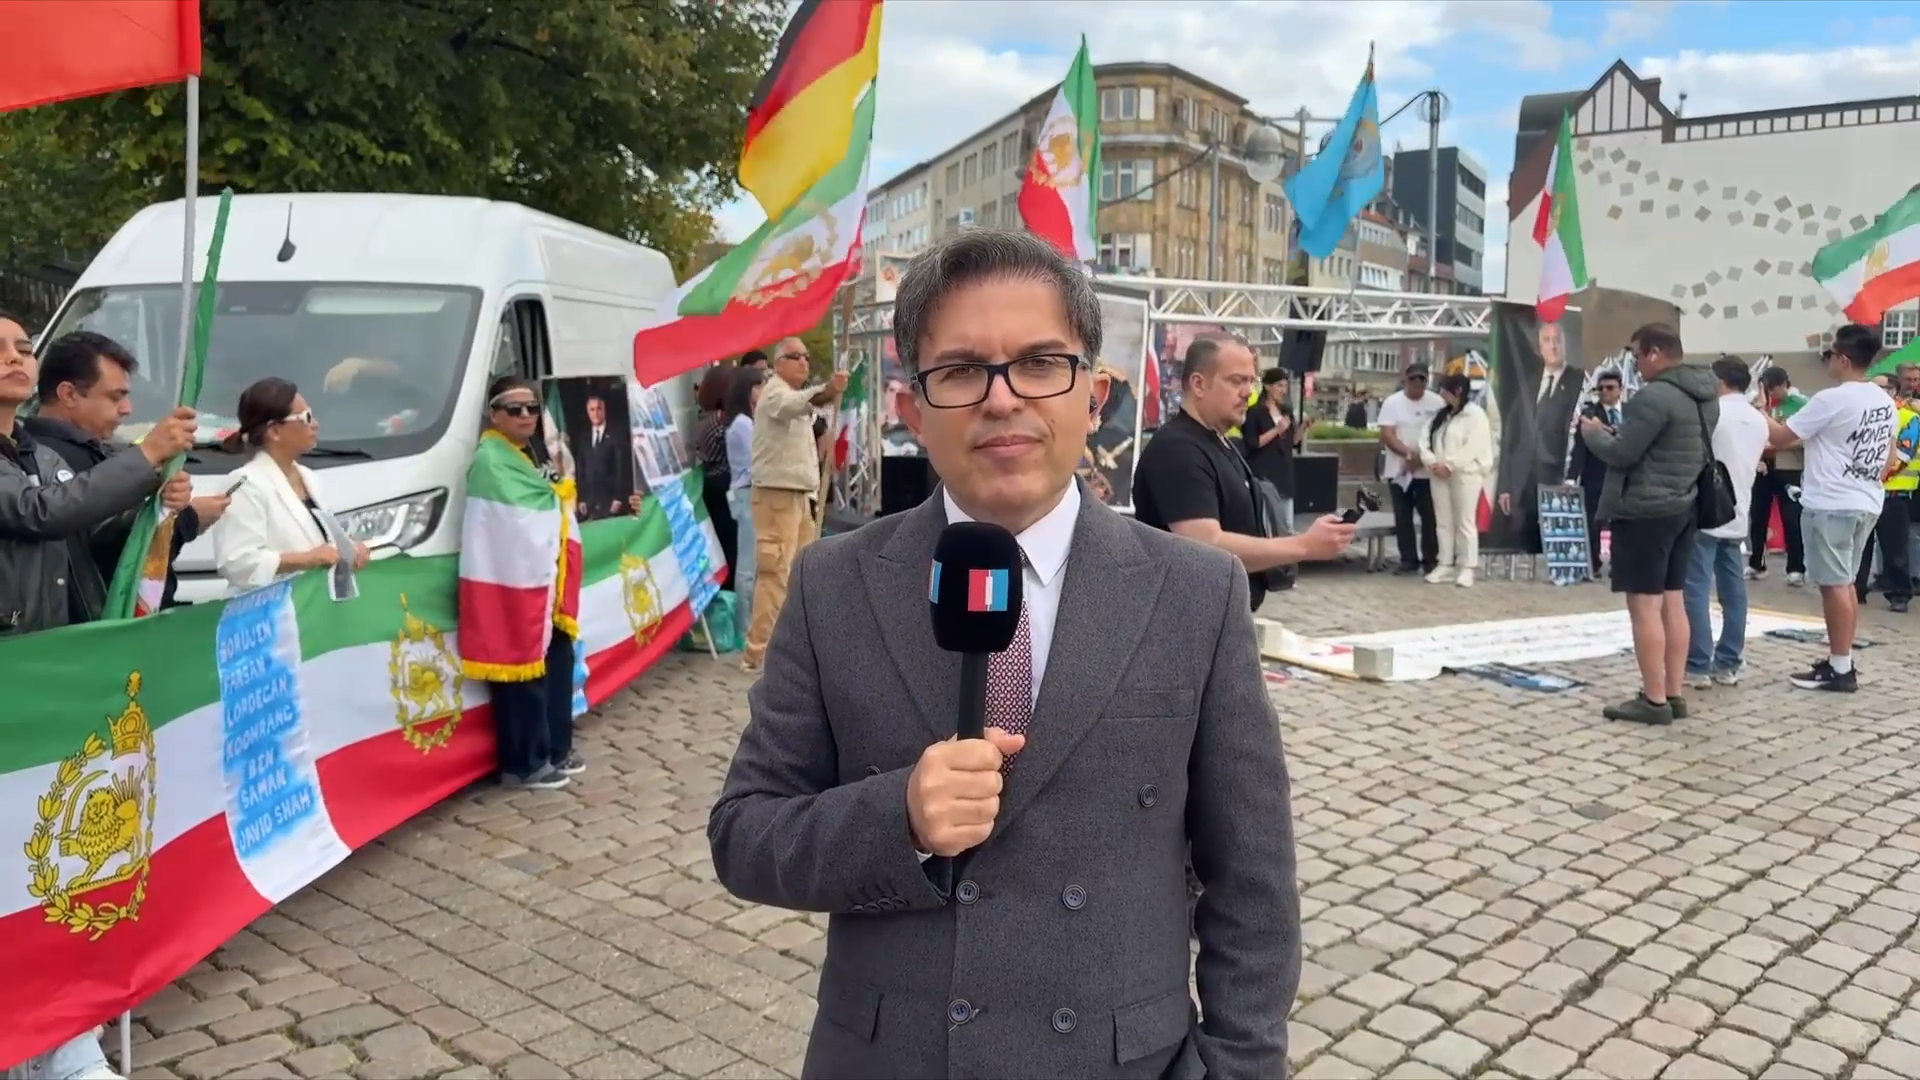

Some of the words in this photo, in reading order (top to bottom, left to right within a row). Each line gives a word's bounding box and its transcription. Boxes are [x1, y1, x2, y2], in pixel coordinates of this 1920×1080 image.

[1860, 405, 1892, 426] NEED
[1853, 444, 1885, 465] FOR
[219, 619, 272, 664] BORUJEN
[224, 656, 267, 698] FARSAN
[248, 747, 274, 780] BEN
[241, 765, 287, 809] SAMAN
[240, 812, 273, 852] JAVID
